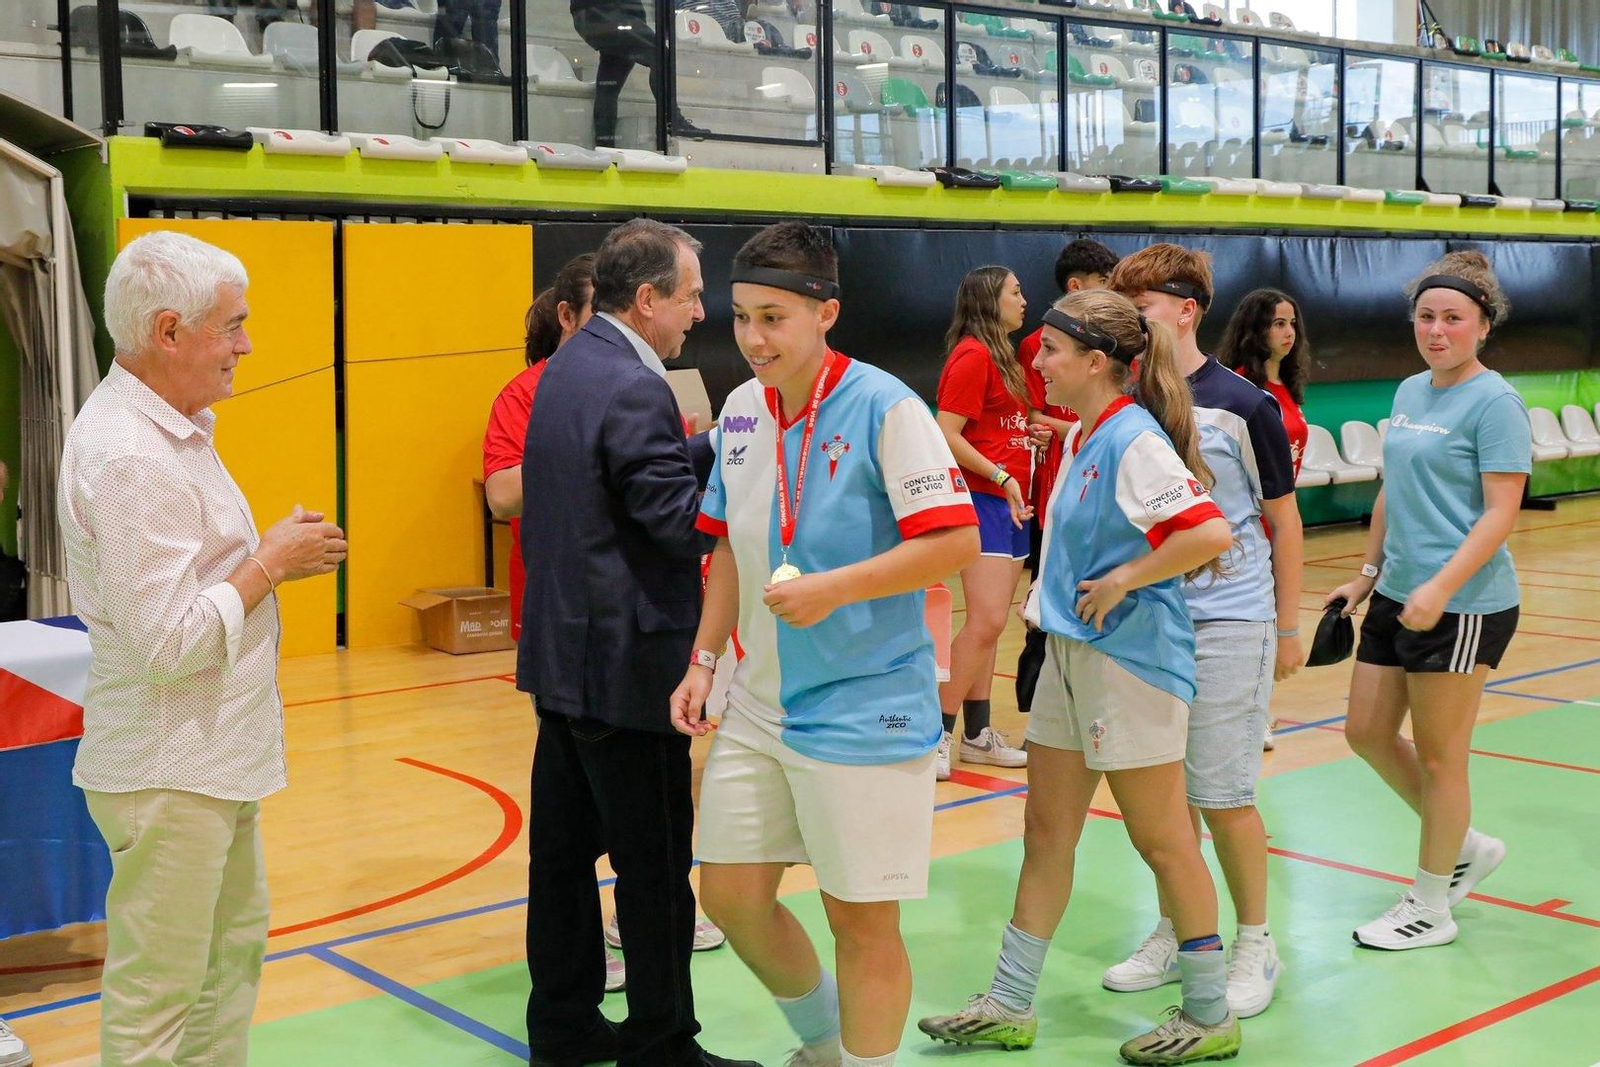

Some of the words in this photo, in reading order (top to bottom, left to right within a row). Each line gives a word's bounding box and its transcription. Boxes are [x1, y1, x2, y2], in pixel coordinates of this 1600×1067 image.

[815, 366, 830, 398] CONCELLO
[811, 399, 819, 409] DE
[808, 410, 817, 428] VIGO
[1391, 414, 1451, 435] Champion
[904, 473, 946, 489] CONCELLO
[910, 486, 922, 495] DE
[924, 482, 943, 491] VIGO
[1145, 484, 1184, 507] CONCELLO
[1151, 501, 1162, 511] DE
[1164, 492, 1182, 505] VIGO
[879, 714, 911, 723] Authentic
[883, 872, 909, 881] KIPSTA
